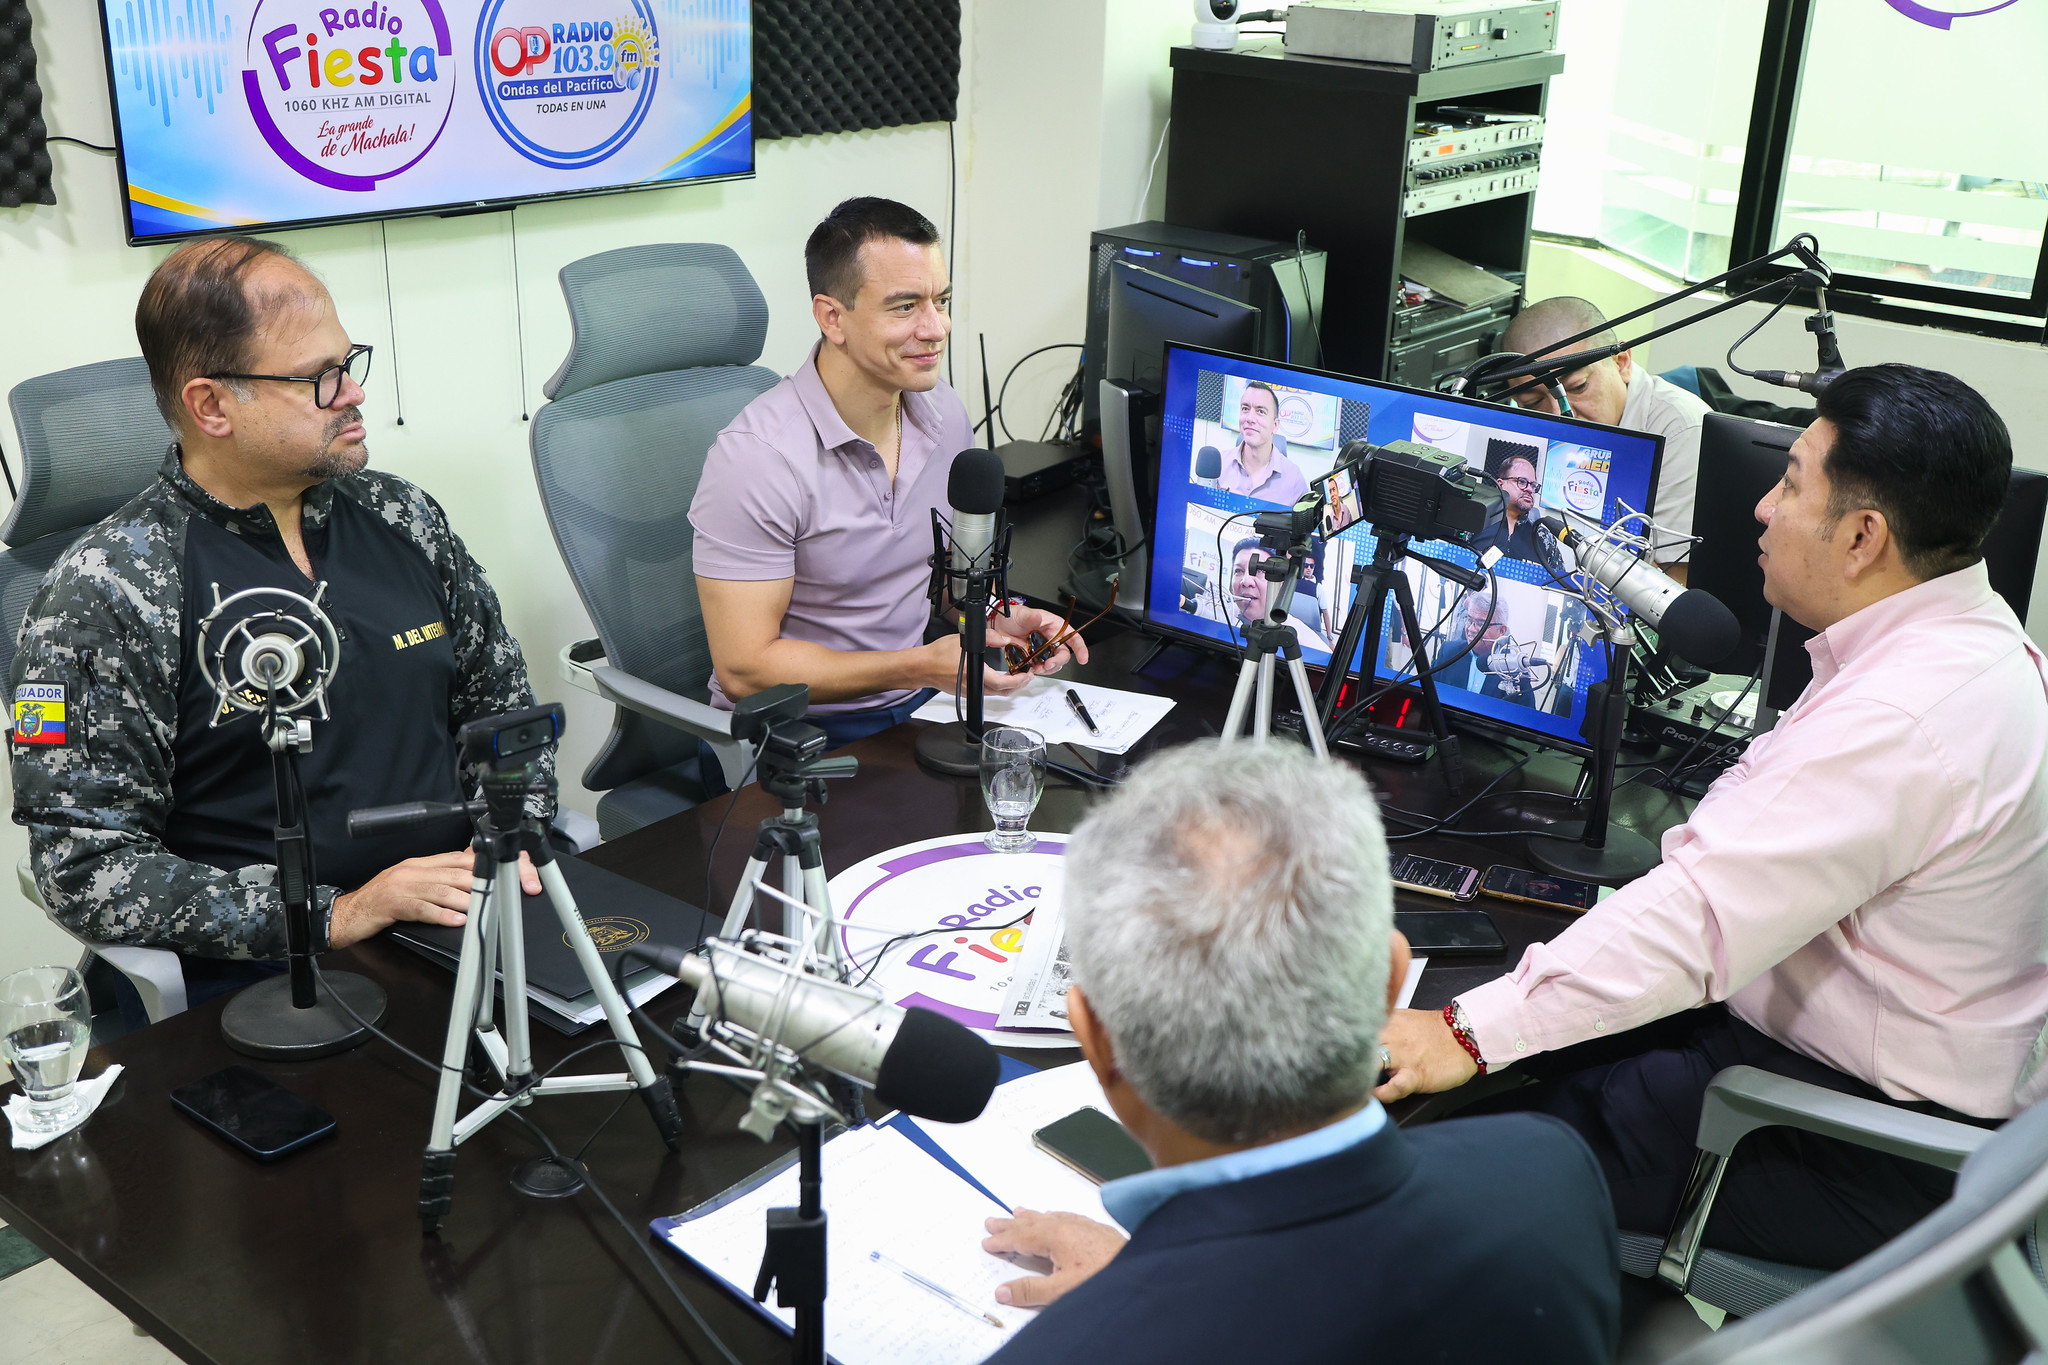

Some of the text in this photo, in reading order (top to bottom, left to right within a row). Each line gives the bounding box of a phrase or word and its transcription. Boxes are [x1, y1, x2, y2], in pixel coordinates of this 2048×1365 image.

[319, 1, 402, 37] Radio
[552, 20, 614, 45] RADIO
[262, 23, 438, 92] Fiesta
[491, 26, 552, 77] OP
[552, 43, 638, 74] 103.9 fm
[501, 77, 614, 97] Ondas del Pacífico
[284, 92, 431, 113] 1060 KHZ AM DIGITAL
[536, 100, 607, 114] TODAS EN UNA
[317, 114, 374, 141] La grande
[320, 123, 416, 158] de Machala!
[1568, 481, 1599, 497] Fiesta
[392, 634, 408, 650] M.
[405, 629, 424, 646] DEL
[938, 885, 1042, 928] Radio
